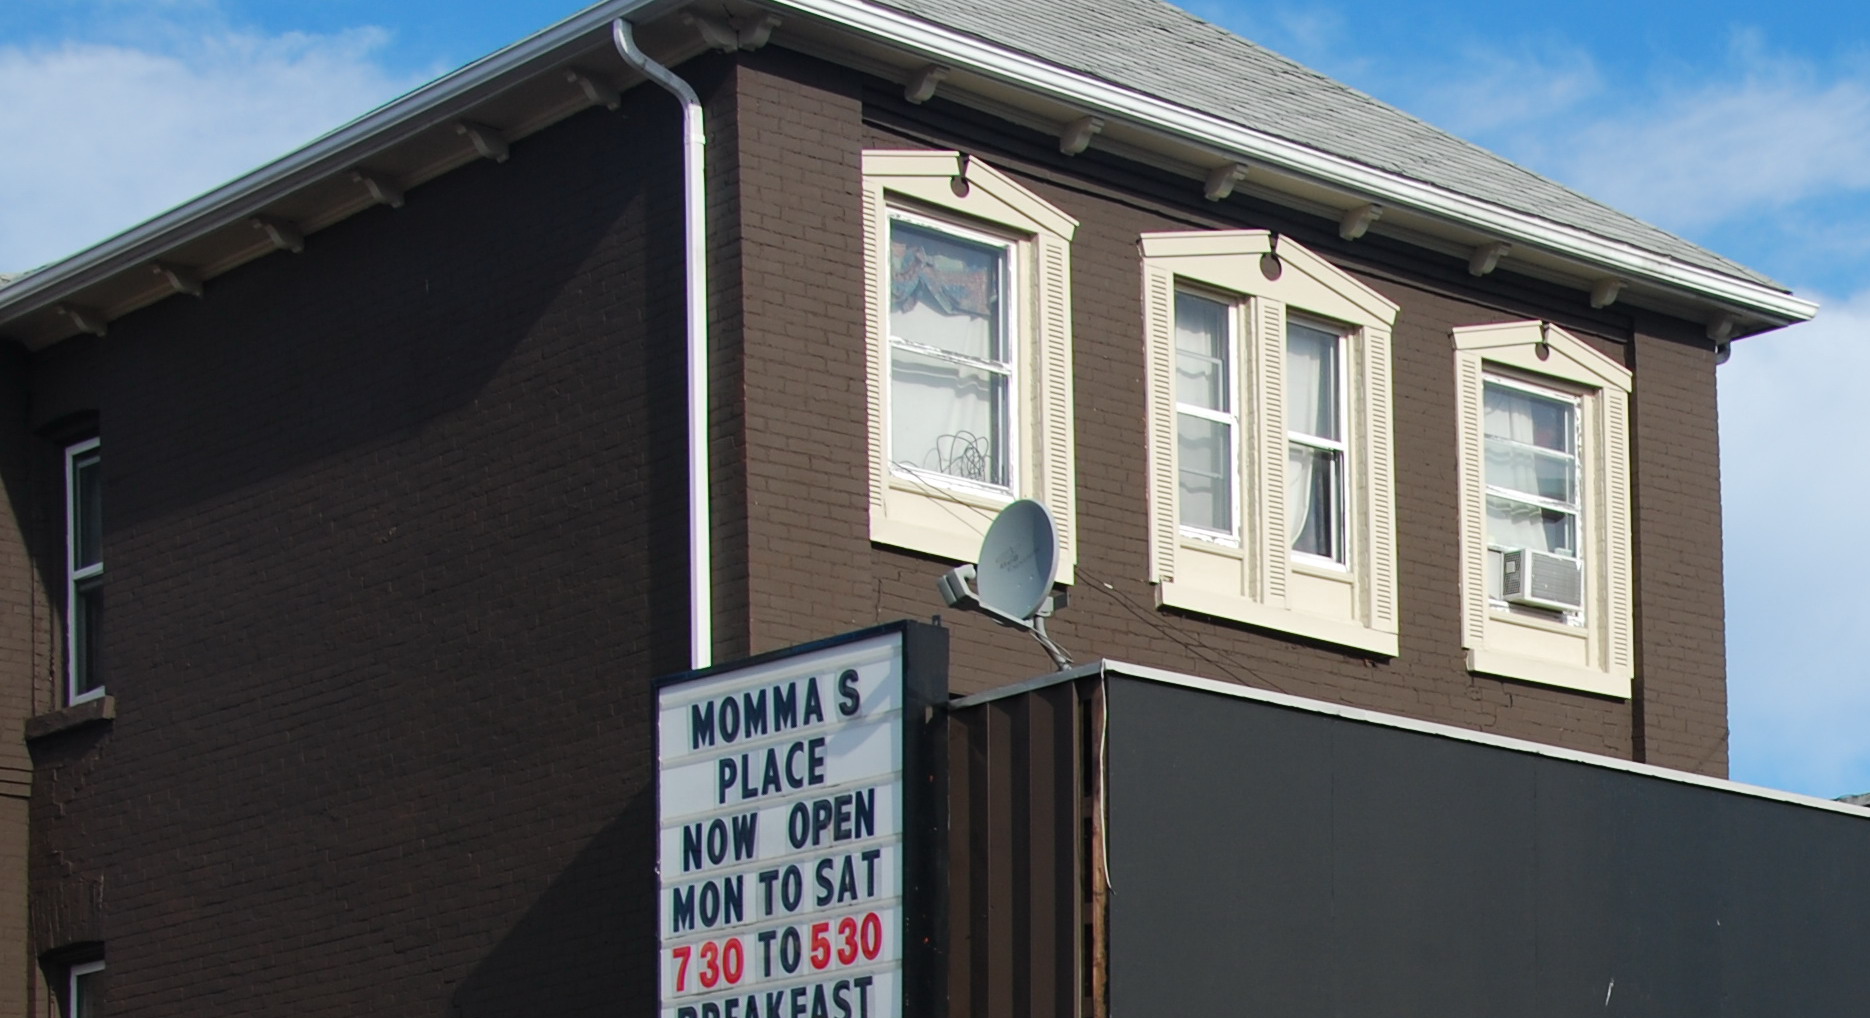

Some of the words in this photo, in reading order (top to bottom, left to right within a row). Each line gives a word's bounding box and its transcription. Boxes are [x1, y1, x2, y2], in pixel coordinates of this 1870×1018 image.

[718, 737, 826, 804] PLACE
[682, 812, 758, 872] NOW
[788, 788, 876, 848] OPEN
[672, 874, 744, 933] MON
[758, 864, 802, 915] TO
[815, 849, 882, 907] SAT
[672, 937, 744, 992] 730
[758, 925, 801, 978] TO
[810, 912, 883, 970] 530
